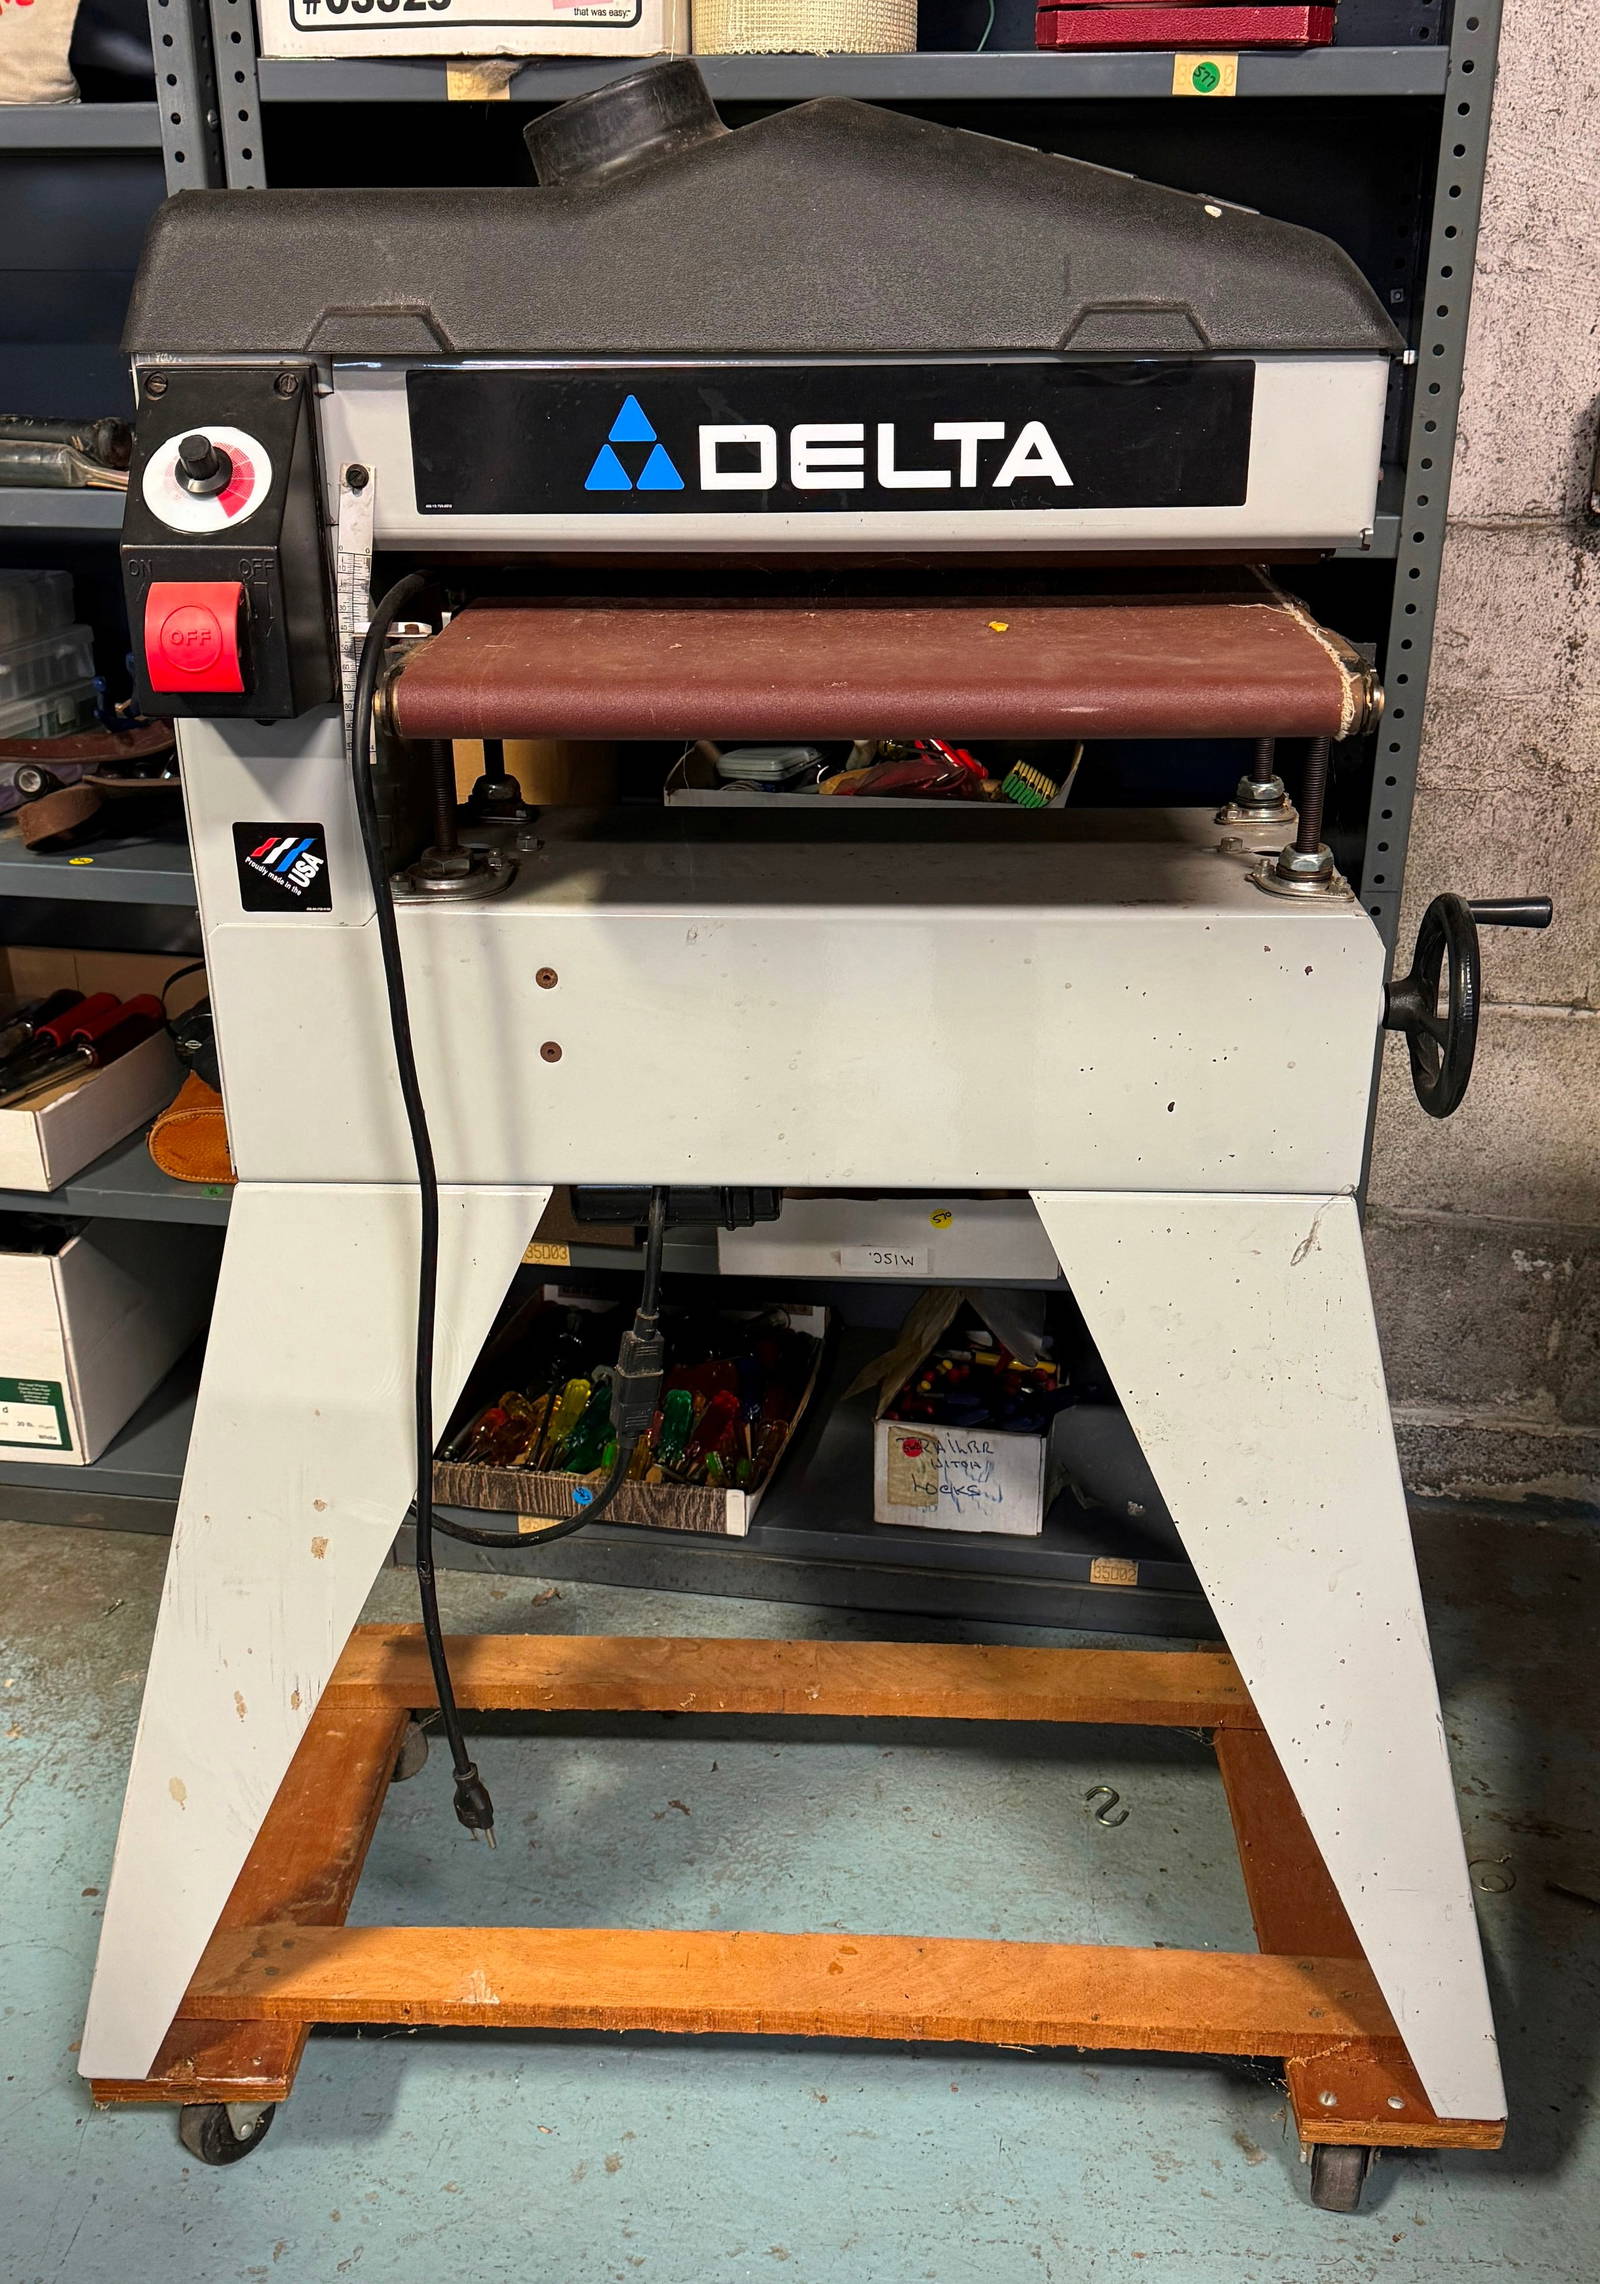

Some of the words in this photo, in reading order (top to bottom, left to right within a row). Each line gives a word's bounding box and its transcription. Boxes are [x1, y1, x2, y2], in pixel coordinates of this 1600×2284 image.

[573, 8, 588, 16] that
[699, 420, 1074, 491] DELTA
[128, 559, 153, 576] ON
[239, 558, 275, 578] OFF
[170, 630, 212, 646] OFF
[245, 856, 268, 876] Proudly
[267, 872, 285, 886] made
[284, 881, 292, 890] in
[291, 885, 302, 897] the
[287, 852, 325, 888] USA
